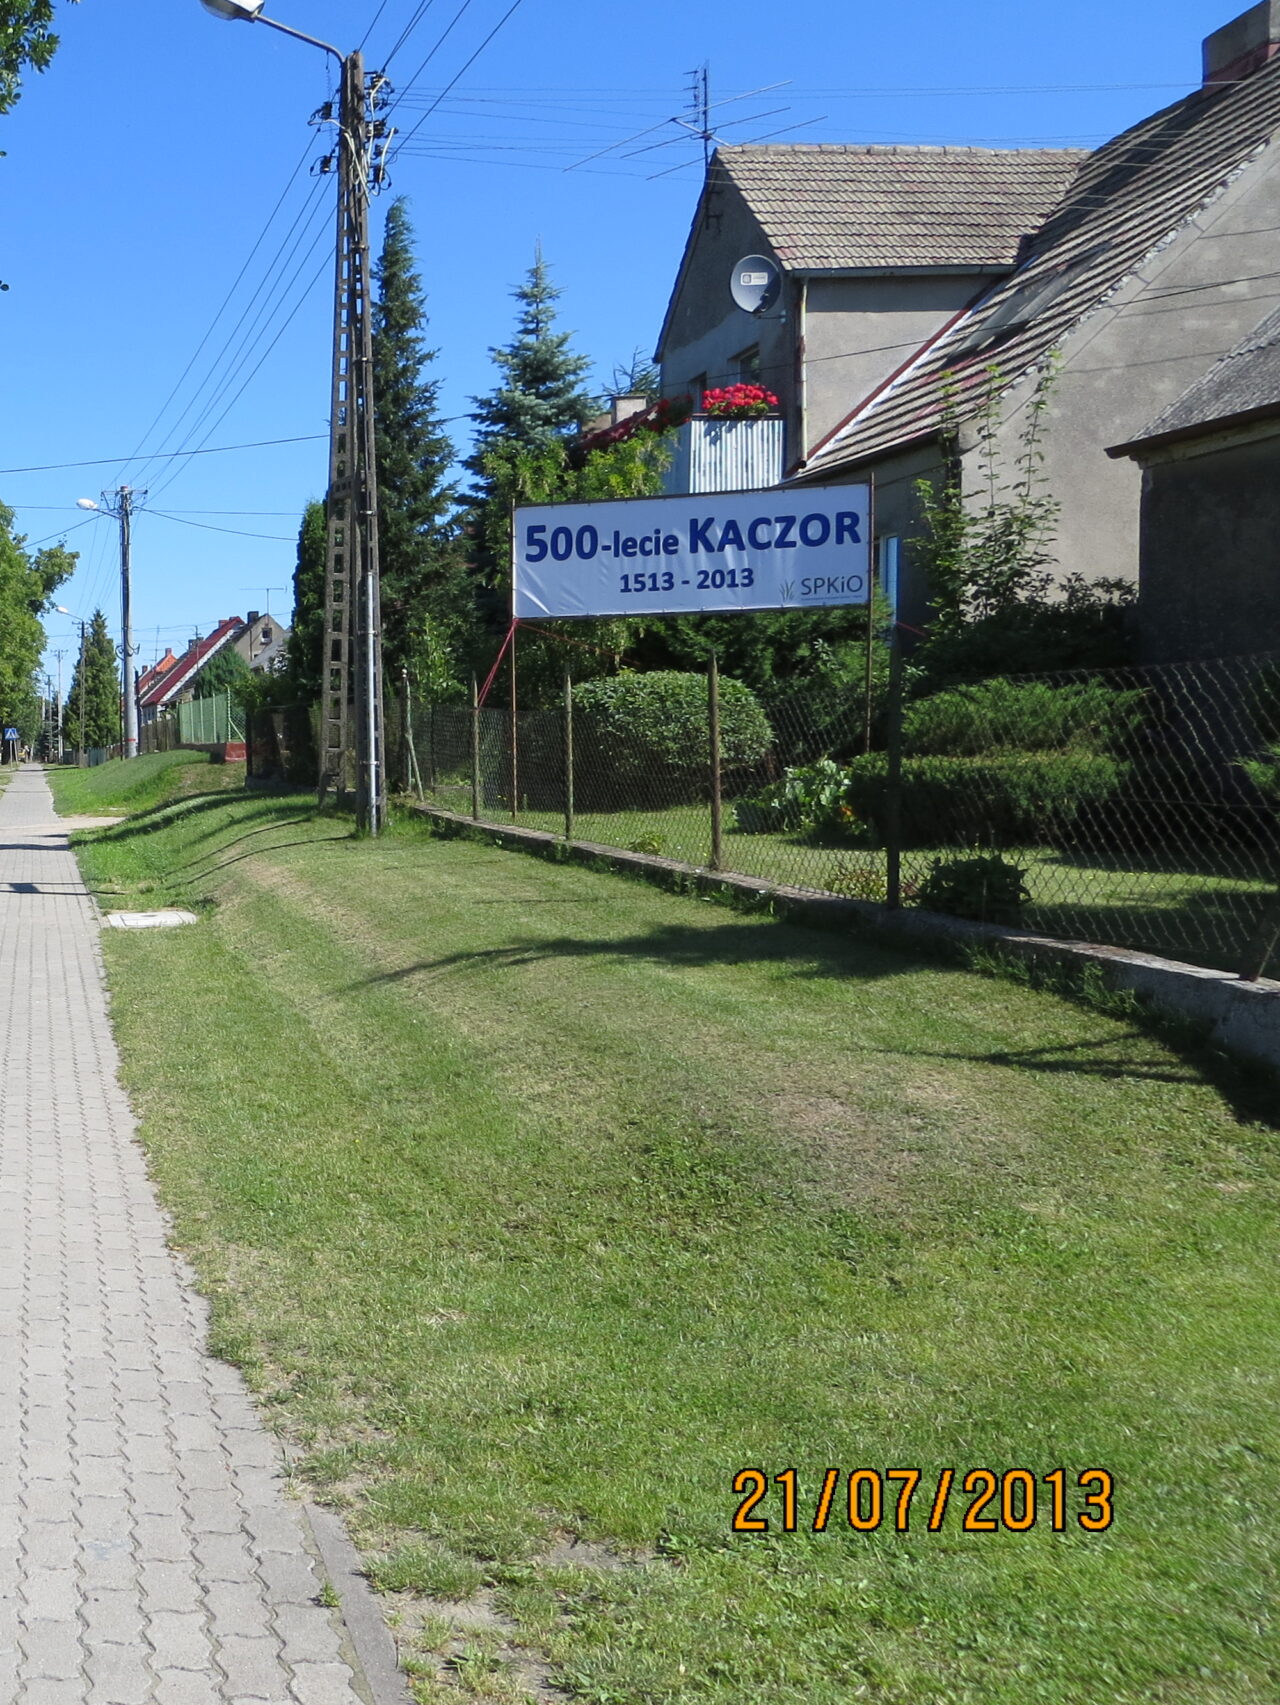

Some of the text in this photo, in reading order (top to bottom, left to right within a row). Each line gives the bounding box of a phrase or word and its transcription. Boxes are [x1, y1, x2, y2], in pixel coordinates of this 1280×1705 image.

[525, 511, 861, 562] 500-lecie KACZOR
[620, 571, 675, 593] 1513
[696, 567, 754, 589] 2013
[800, 575, 863, 595] SPKiO
